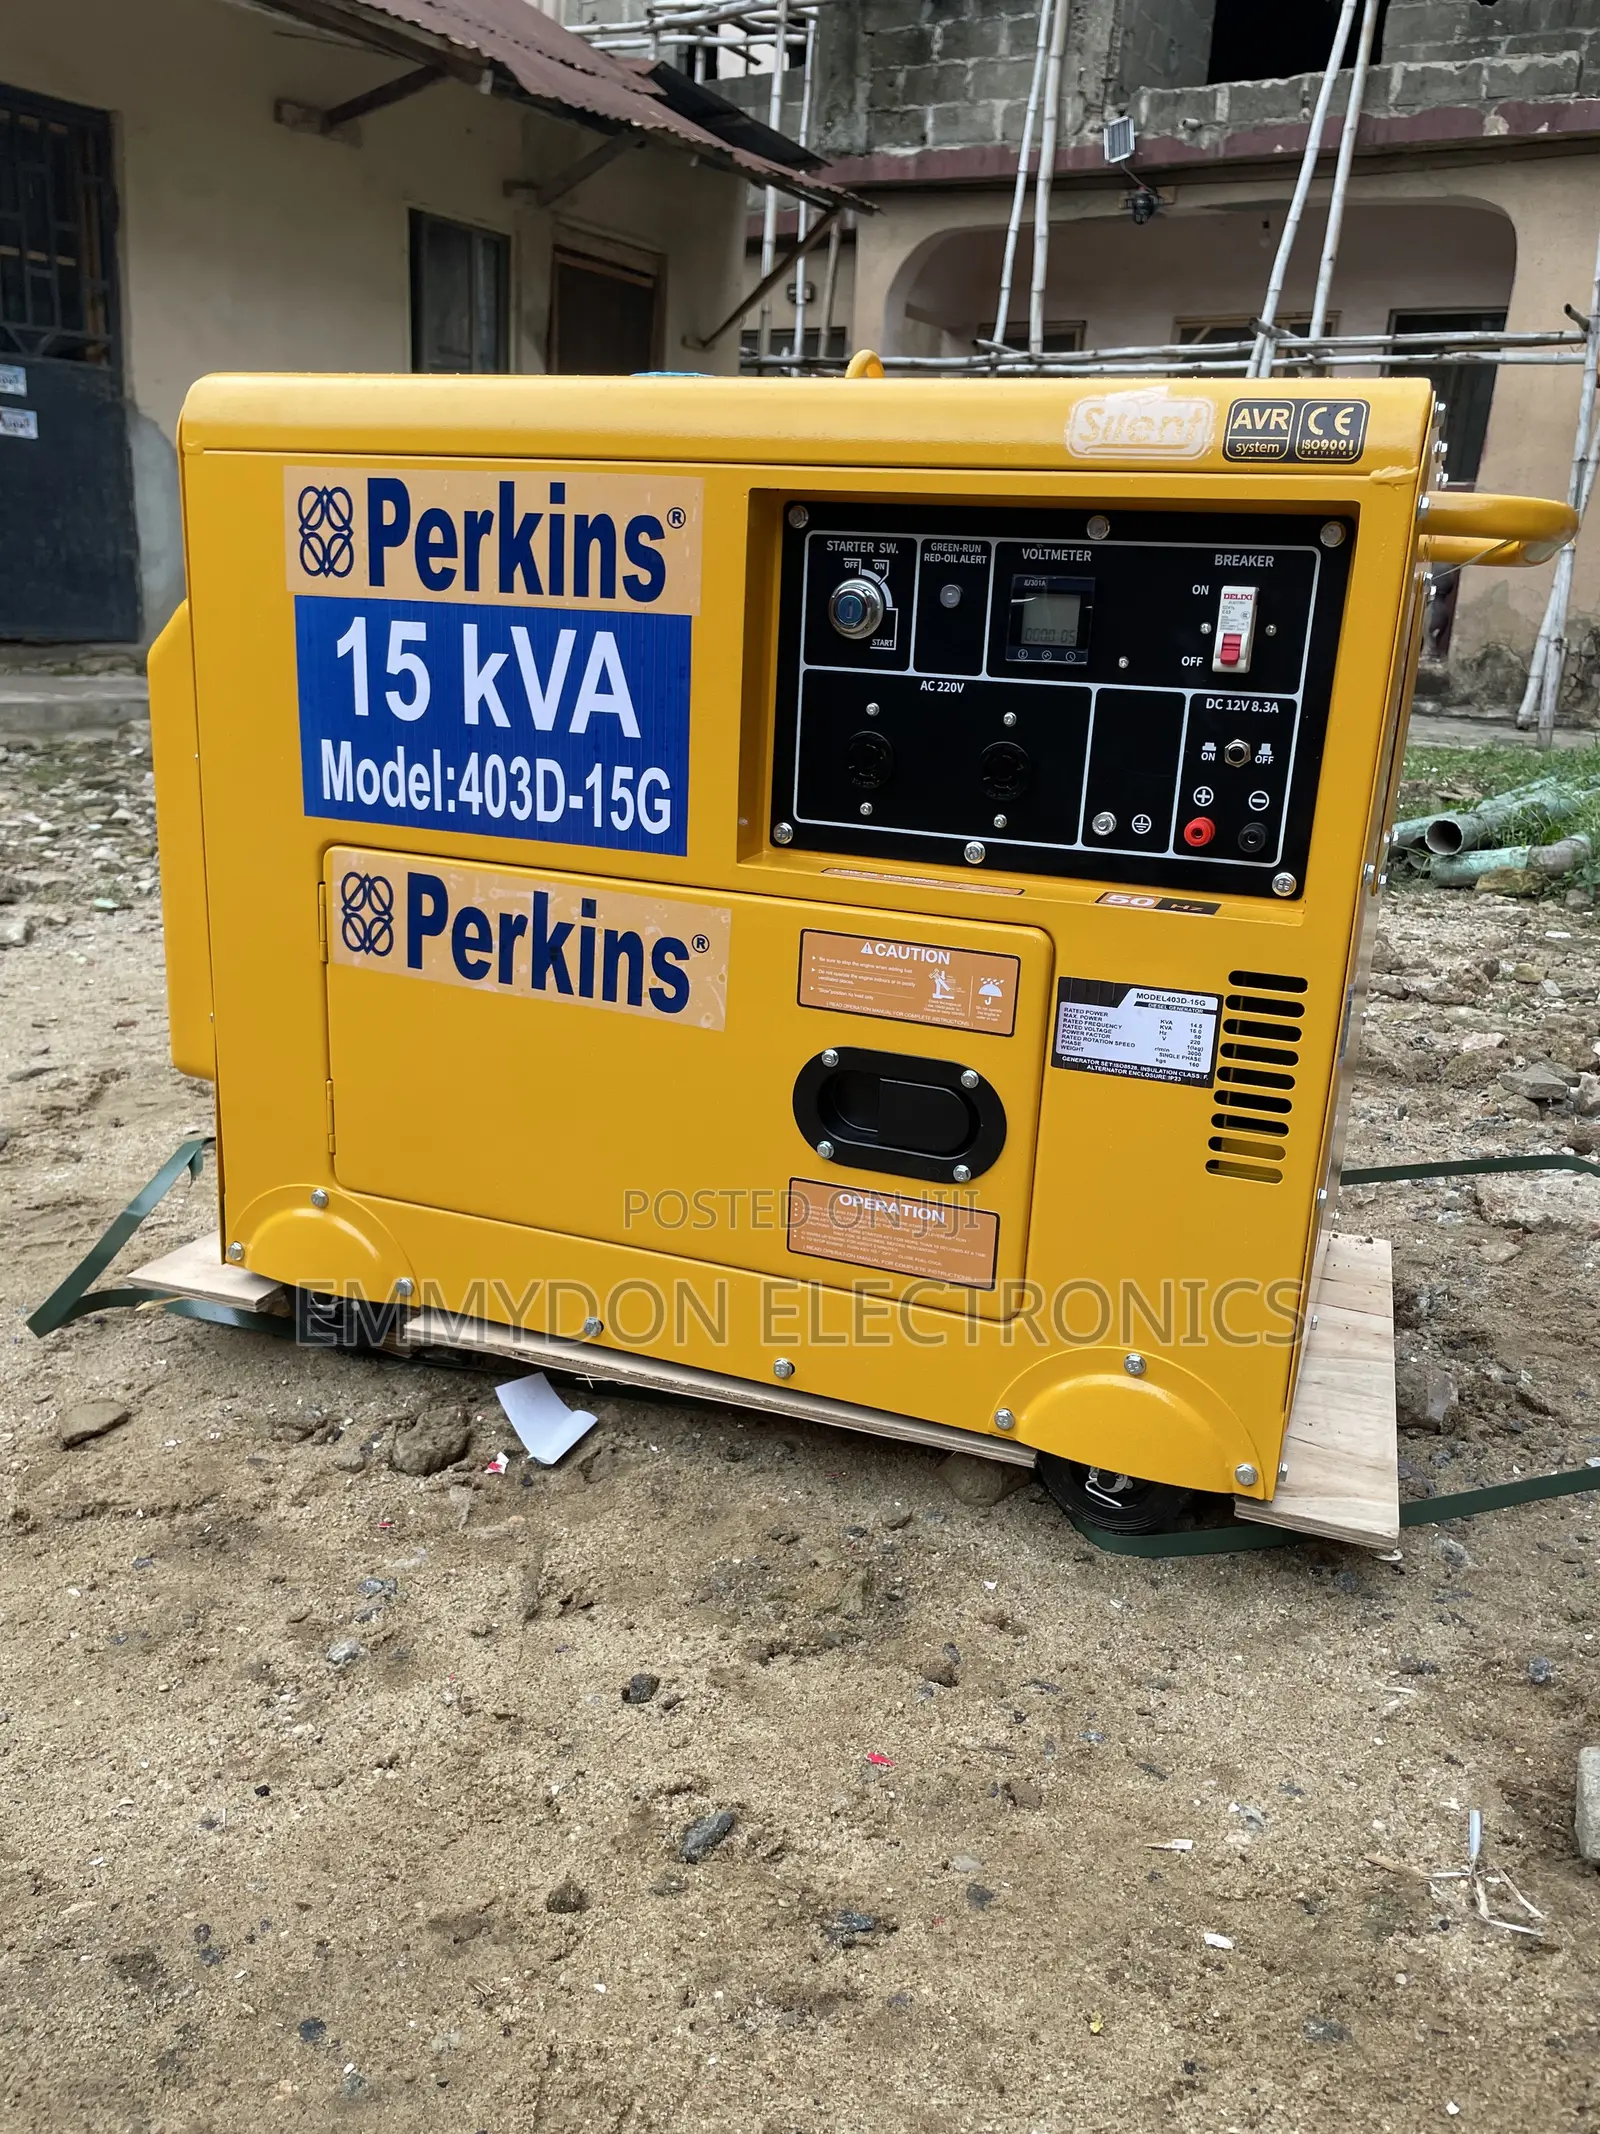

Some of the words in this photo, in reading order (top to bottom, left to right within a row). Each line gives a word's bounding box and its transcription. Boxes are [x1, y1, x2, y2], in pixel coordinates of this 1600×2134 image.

[1232, 408, 1289, 430] AVR
[1308, 406, 1355, 436] CE
[1235, 441, 1280, 455] system
[1301, 439, 1354, 451] ISO9001
[827, 540, 875, 554] STARTER
[879, 542, 900, 555] SW.
[931, 542, 982, 553] GREEN-RUN
[924, 553, 959, 563] RED-OIL
[959, 554, 987, 565] ALERT
[1022, 548, 1092, 562] VOLTMETER
[1214, 554, 1275, 567] BREAKER
[844, 561, 858, 569] OFF
[874, 562, 885, 571] ON
[1192, 585, 1209, 595] ON
[872, 638, 893, 647] START
[1181, 656, 1204, 667] OFF
[336, 616, 431, 722] 15
[463, 623, 641, 739] kVA
[920, 680, 935, 691] AC
[937, 681, 965, 694] 220V
[1206, 698, 1223, 709] DC
[1226, 699, 1250, 711] 12V
[1251, 701, 1279, 713] 8.3A
[1201, 752, 1216, 761] ON
[1255, 755, 1274, 764] OFF
[321, 739, 671, 835] Model:403D-15G
[1106, 894, 1155, 907] 50
[1170, 903, 1204, 911] Hz
[875, 943, 951, 965] CAUTION
[1136, 993, 1206, 1006] MODEL403D-15G
[1168, 1005, 1204, 1014] GENERATOR
[1084, 1026, 1112, 1034] VOLTAGE
[1085, 1021, 1122, 1029] FREQUENCY
[1083, 1037, 1113, 1045] ROTATION
[1062, 1056, 1100, 1065] GENERATOR
[1140, 1066, 1178, 1076] INSULATION
[1087, 1065, 1127, 1074] ALTERNATOR
[839, 1193, 945, 1223] OPERATION
